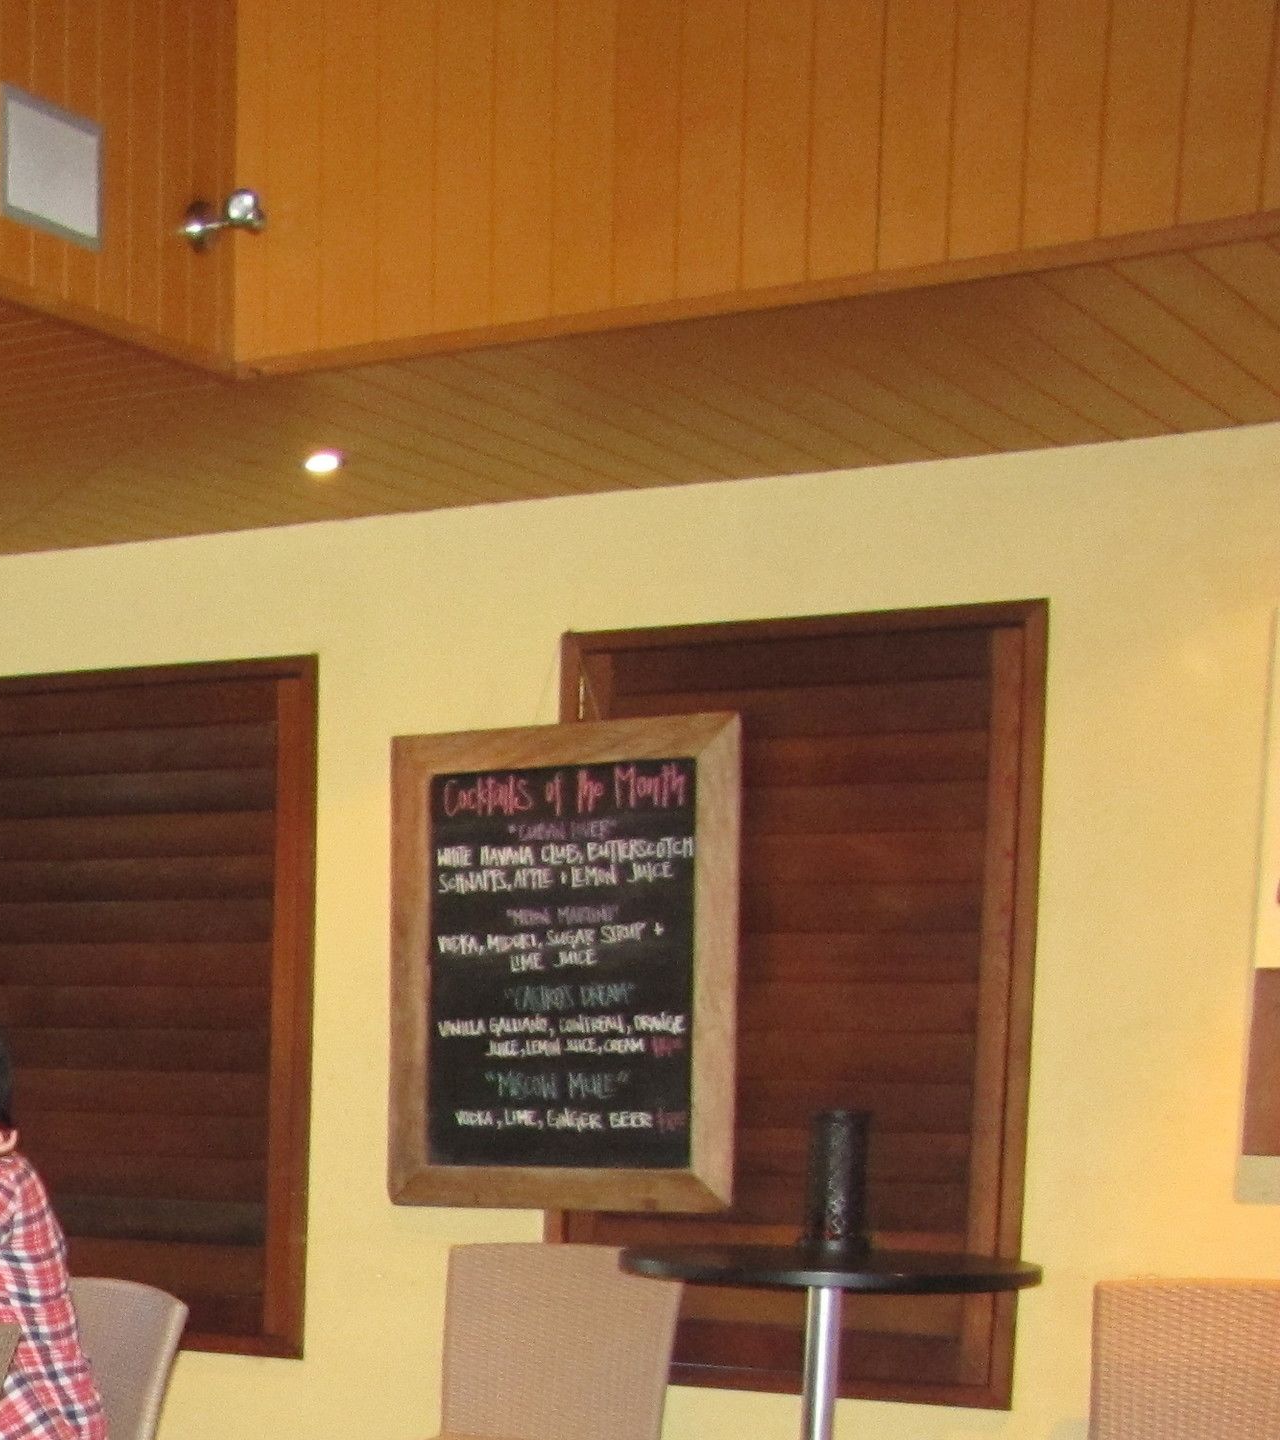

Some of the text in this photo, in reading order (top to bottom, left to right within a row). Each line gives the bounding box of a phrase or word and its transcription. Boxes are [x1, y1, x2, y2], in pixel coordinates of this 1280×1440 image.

[545, 772, 563, 817] of
[614, 763, 688, 809] Month
[586, 836, 694, 863] BUTTERSCOTCH
[608, 1110, 654, 1129] BEER
